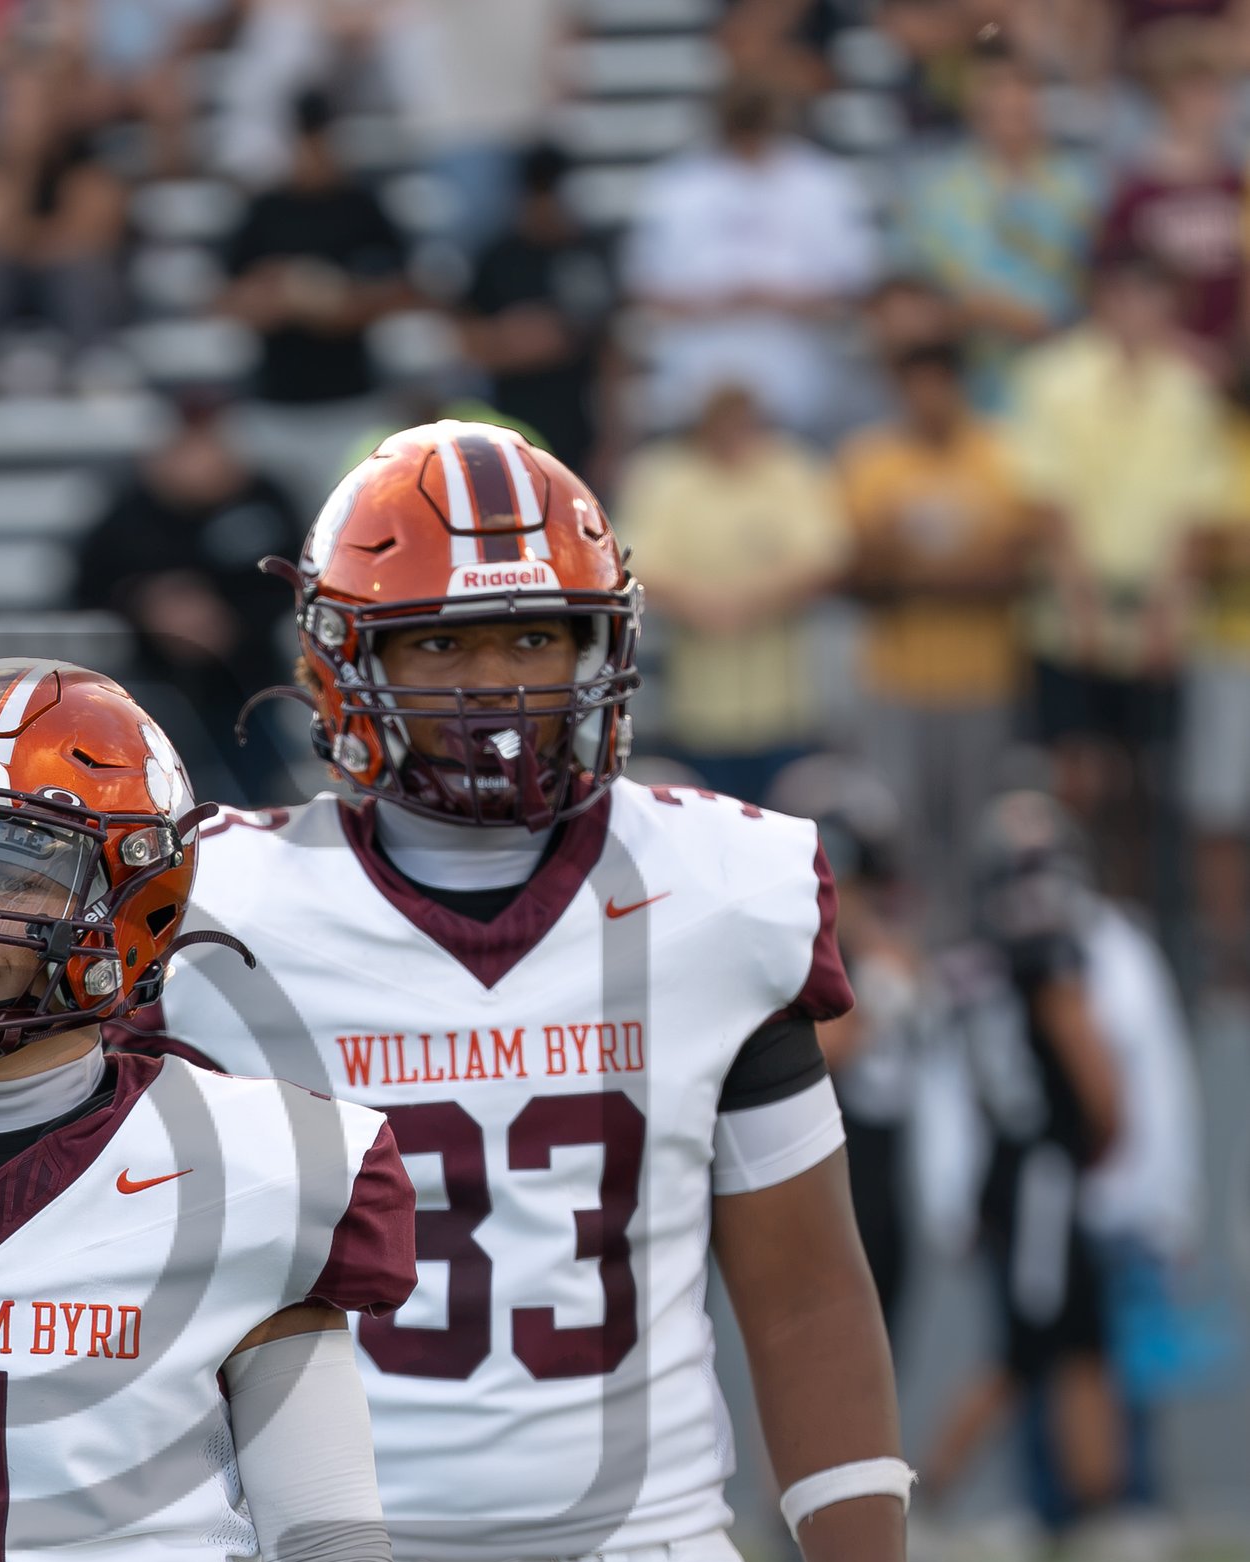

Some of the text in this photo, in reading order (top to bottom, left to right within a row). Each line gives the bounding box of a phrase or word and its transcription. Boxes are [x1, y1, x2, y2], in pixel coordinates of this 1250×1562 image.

[464, 568, 546, 587] Riddell
[336, 1022, 645, 1087] WILLIAM BYRD
[29, 1301, 141, 1360] BYRD
